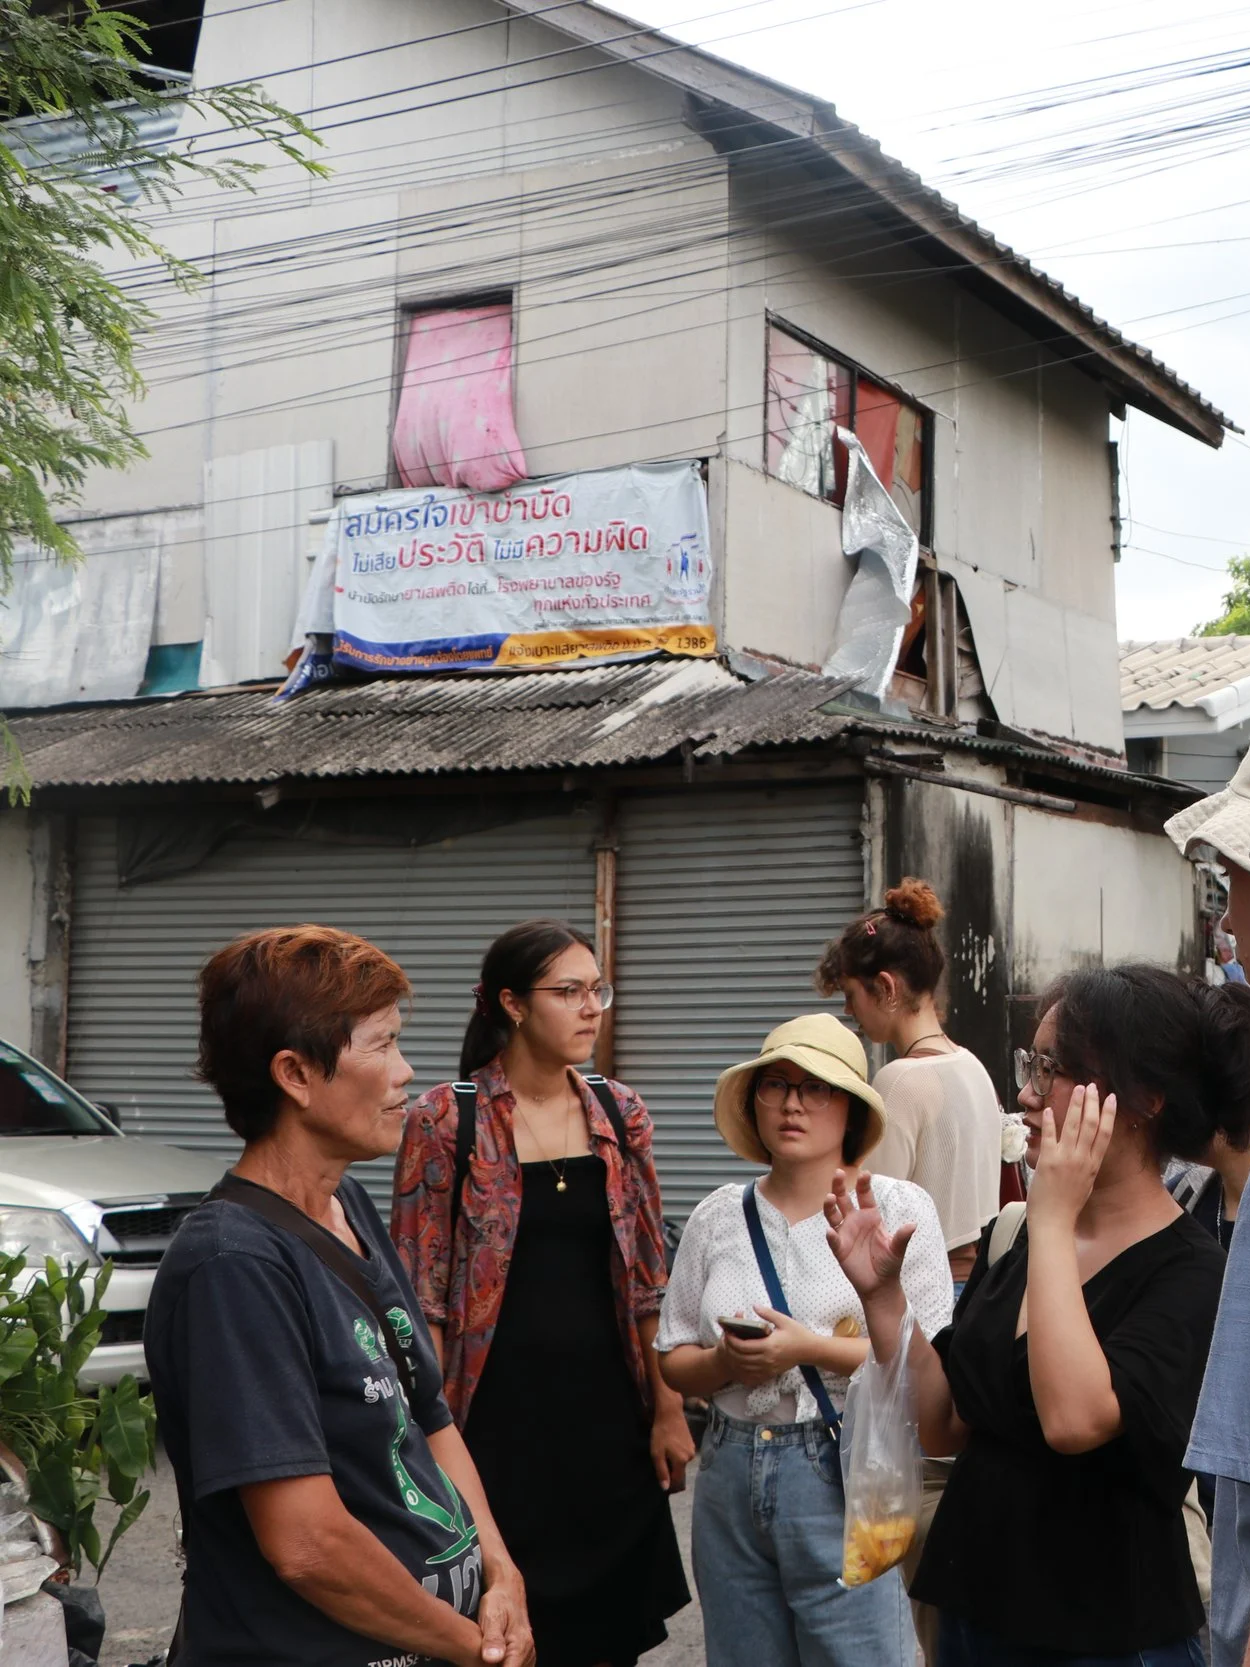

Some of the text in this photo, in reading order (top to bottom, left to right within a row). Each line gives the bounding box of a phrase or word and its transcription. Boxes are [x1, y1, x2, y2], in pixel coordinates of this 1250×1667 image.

[345, 488, 571, 537] สมัครใจเข้าบำบัด
[352, 521, 648, 573] ไม่เสียประวัติ ไม่มีความผิด
[677, 637, 707, 650] 1386
